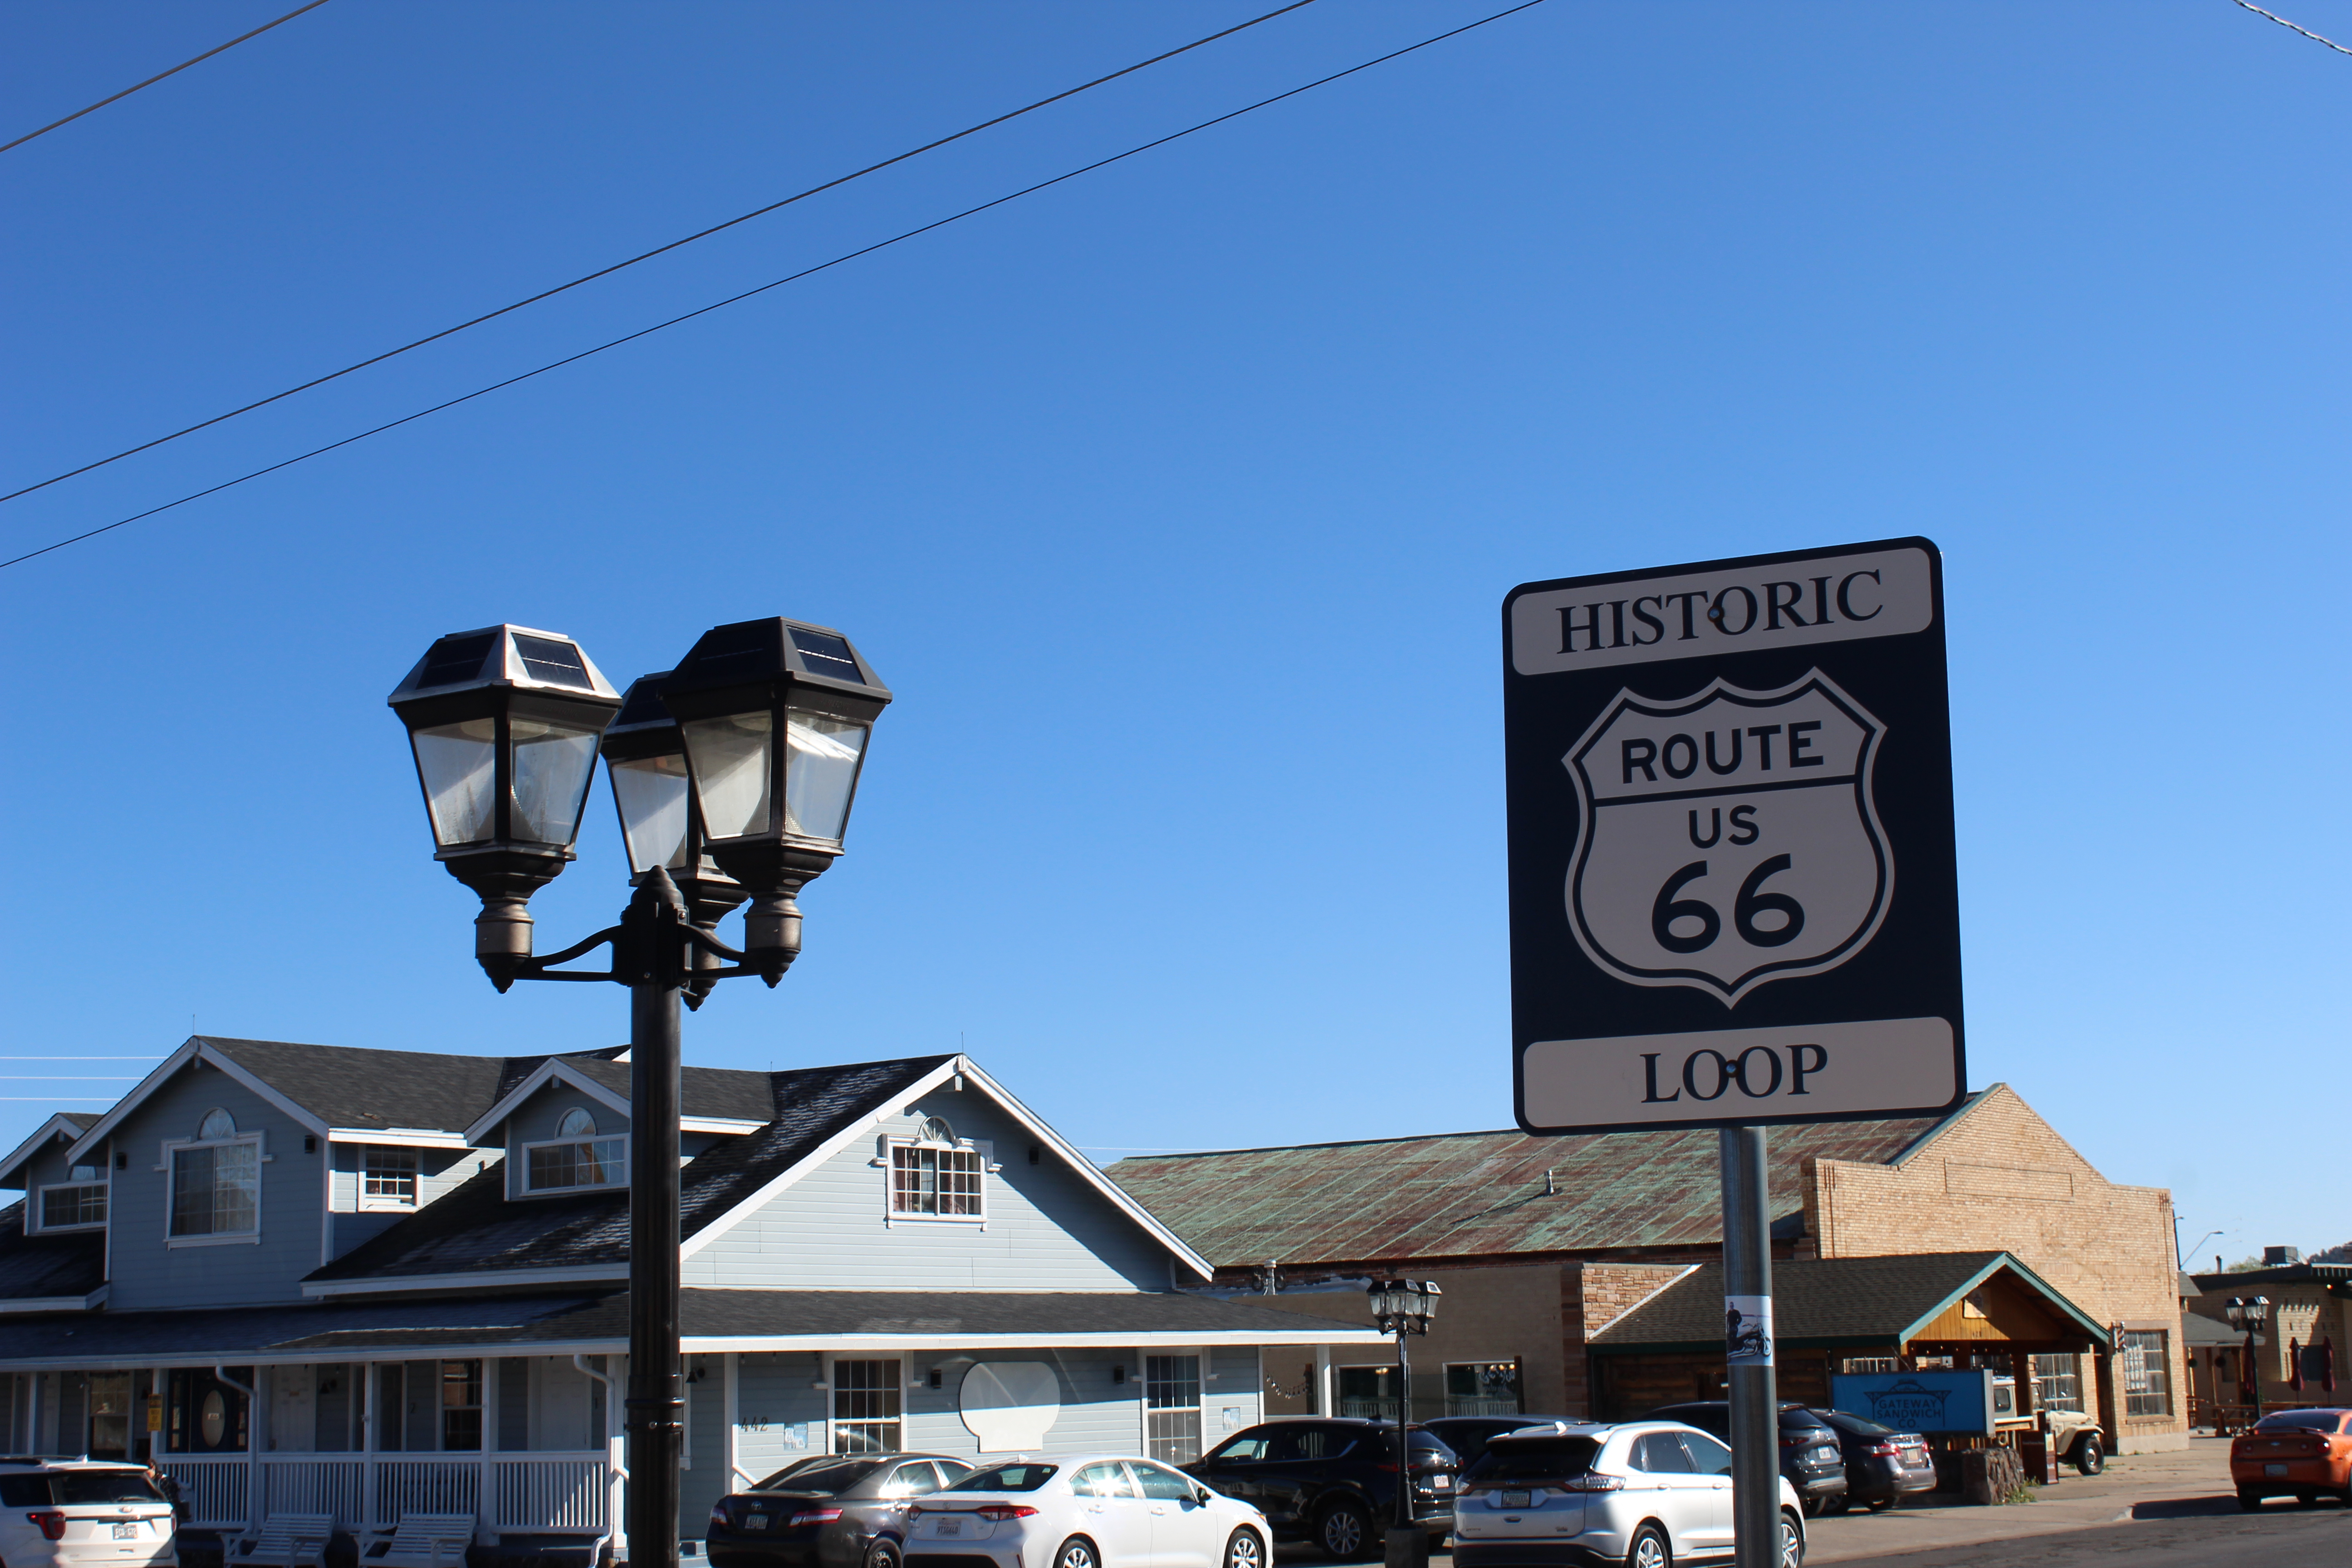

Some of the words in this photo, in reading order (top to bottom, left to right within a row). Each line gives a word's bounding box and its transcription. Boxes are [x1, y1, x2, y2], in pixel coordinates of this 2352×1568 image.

[1556, 569, 1883, 654] HISTORIC
[1622, 720, 1823, 784] ROUTE
[1688, 805, 1759, 849] US
[1651, 853, 1805, 954] 66
[1639, 1044, 1828, 1103] LOOP
[740, 1416, 769, 1432] 442
[1877, 1409, 1940, 1418] SANDWICH
[1879, 1399, 1936, 1408] GATEWAY
[1898, 1419, 1920, 1428] CO.
